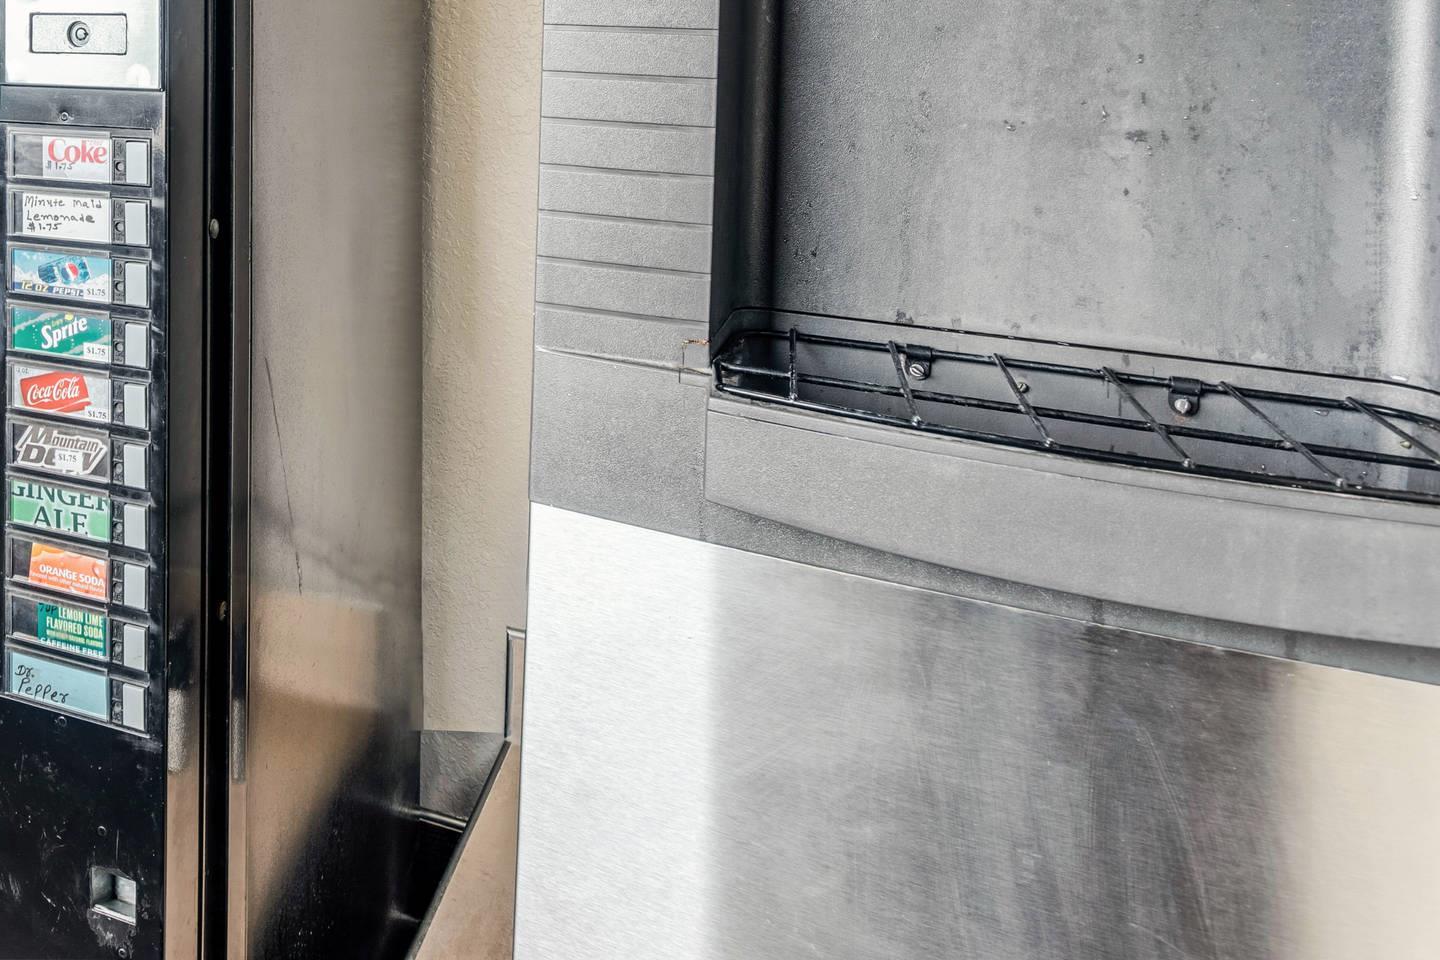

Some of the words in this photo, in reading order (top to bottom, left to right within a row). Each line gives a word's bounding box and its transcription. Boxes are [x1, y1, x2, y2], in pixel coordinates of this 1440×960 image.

[47, 138, 108, 164] Coke
[24, 195, 65, 208] Minute
[26, 209, 95, 223] Lemonade
[21, 280, 33, 290] 12
[86, 288, 105, 297] $1.75
[41, 317, 88, 349] Sprite
[86, 347, 106, 356] $1.75
[27, 376, 80, 406] Coca-Cola
[87, 410, 107, 420] $1.75
[16, 424, 100, 453] Mountain
[58, 453, 77, 463] $1.75
[39, 563, 78, 580] ORANGE
[79, 573, 105, 587] SODA
[58, 606, 83, 622] LEMON
[85, 612, 103, 627] LIME
[46, 616, 82, 635] FLAVORED
[83, 625, 103, 639] SODA
[15, 665, 35, 678] Dr.
[18, 677, 69, 704] Pepper
